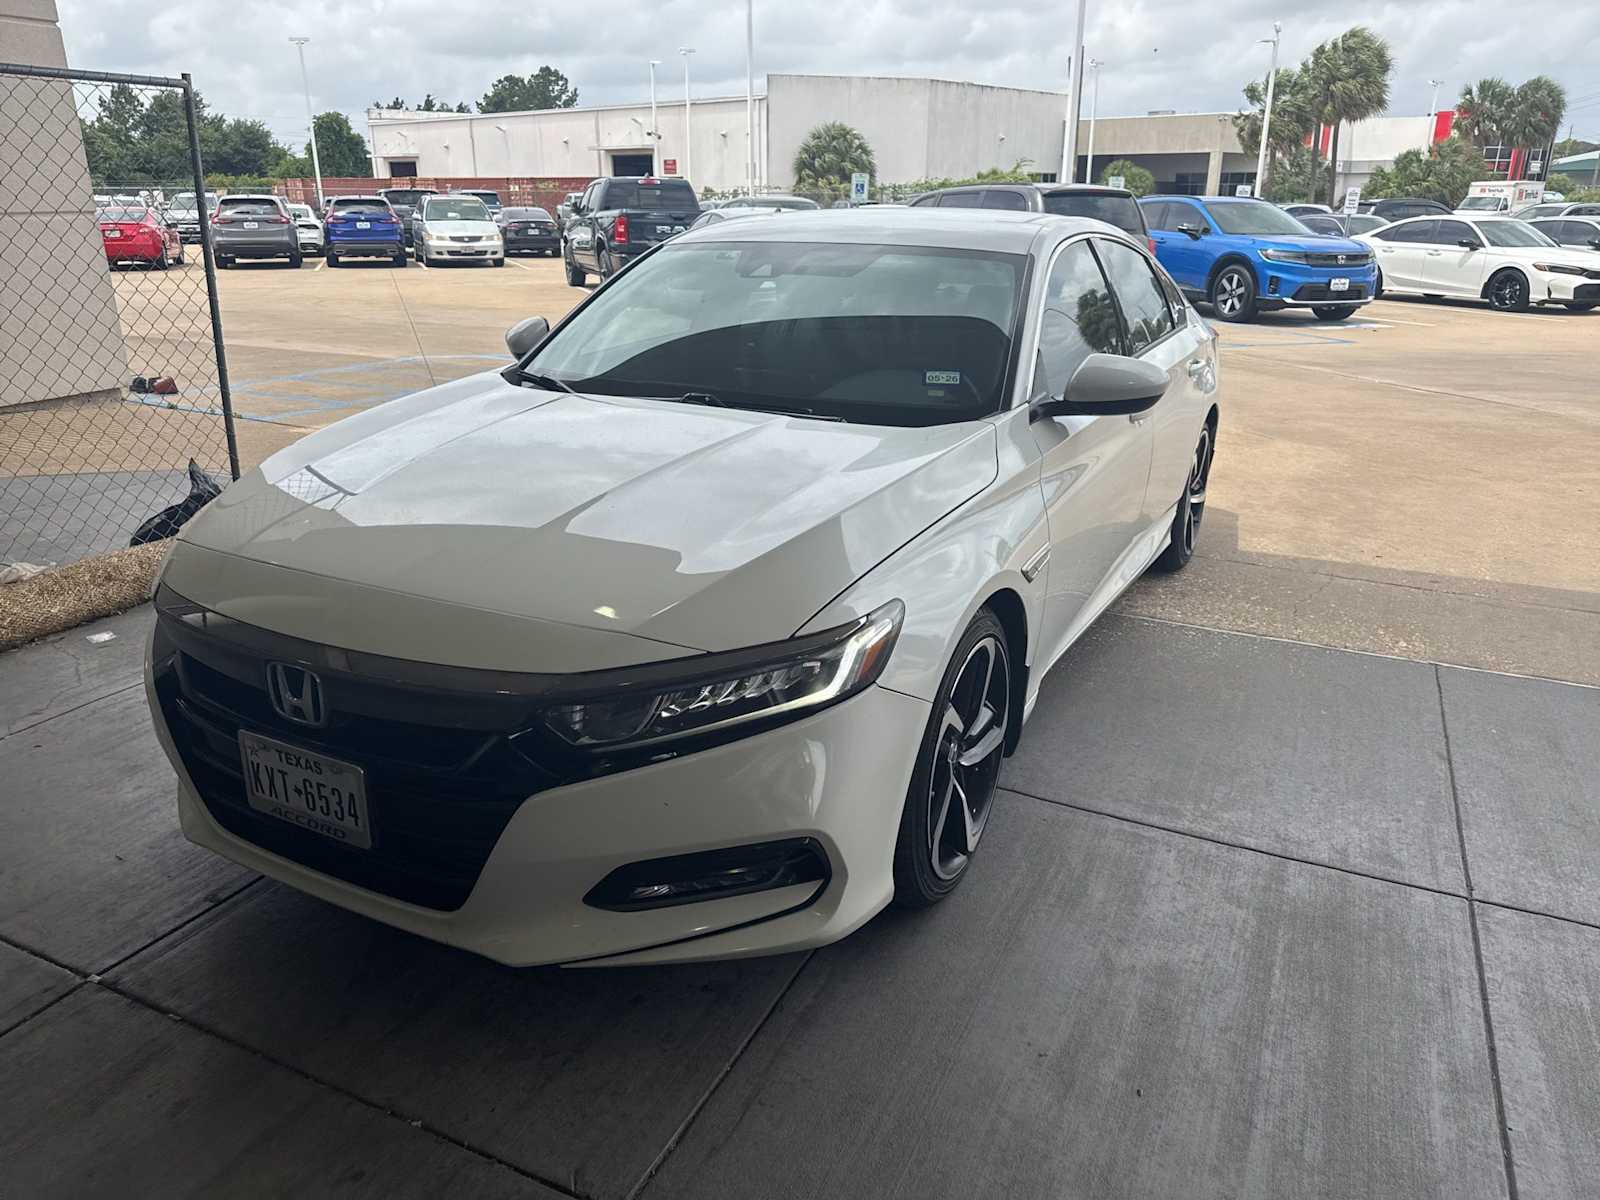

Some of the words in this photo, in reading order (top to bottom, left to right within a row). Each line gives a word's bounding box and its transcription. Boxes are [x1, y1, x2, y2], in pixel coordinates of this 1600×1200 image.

[655, 225, 690, 234] RA
[274, 749, 323, 775] TEXAS
[270, 807, 347, 838] ACCORD
